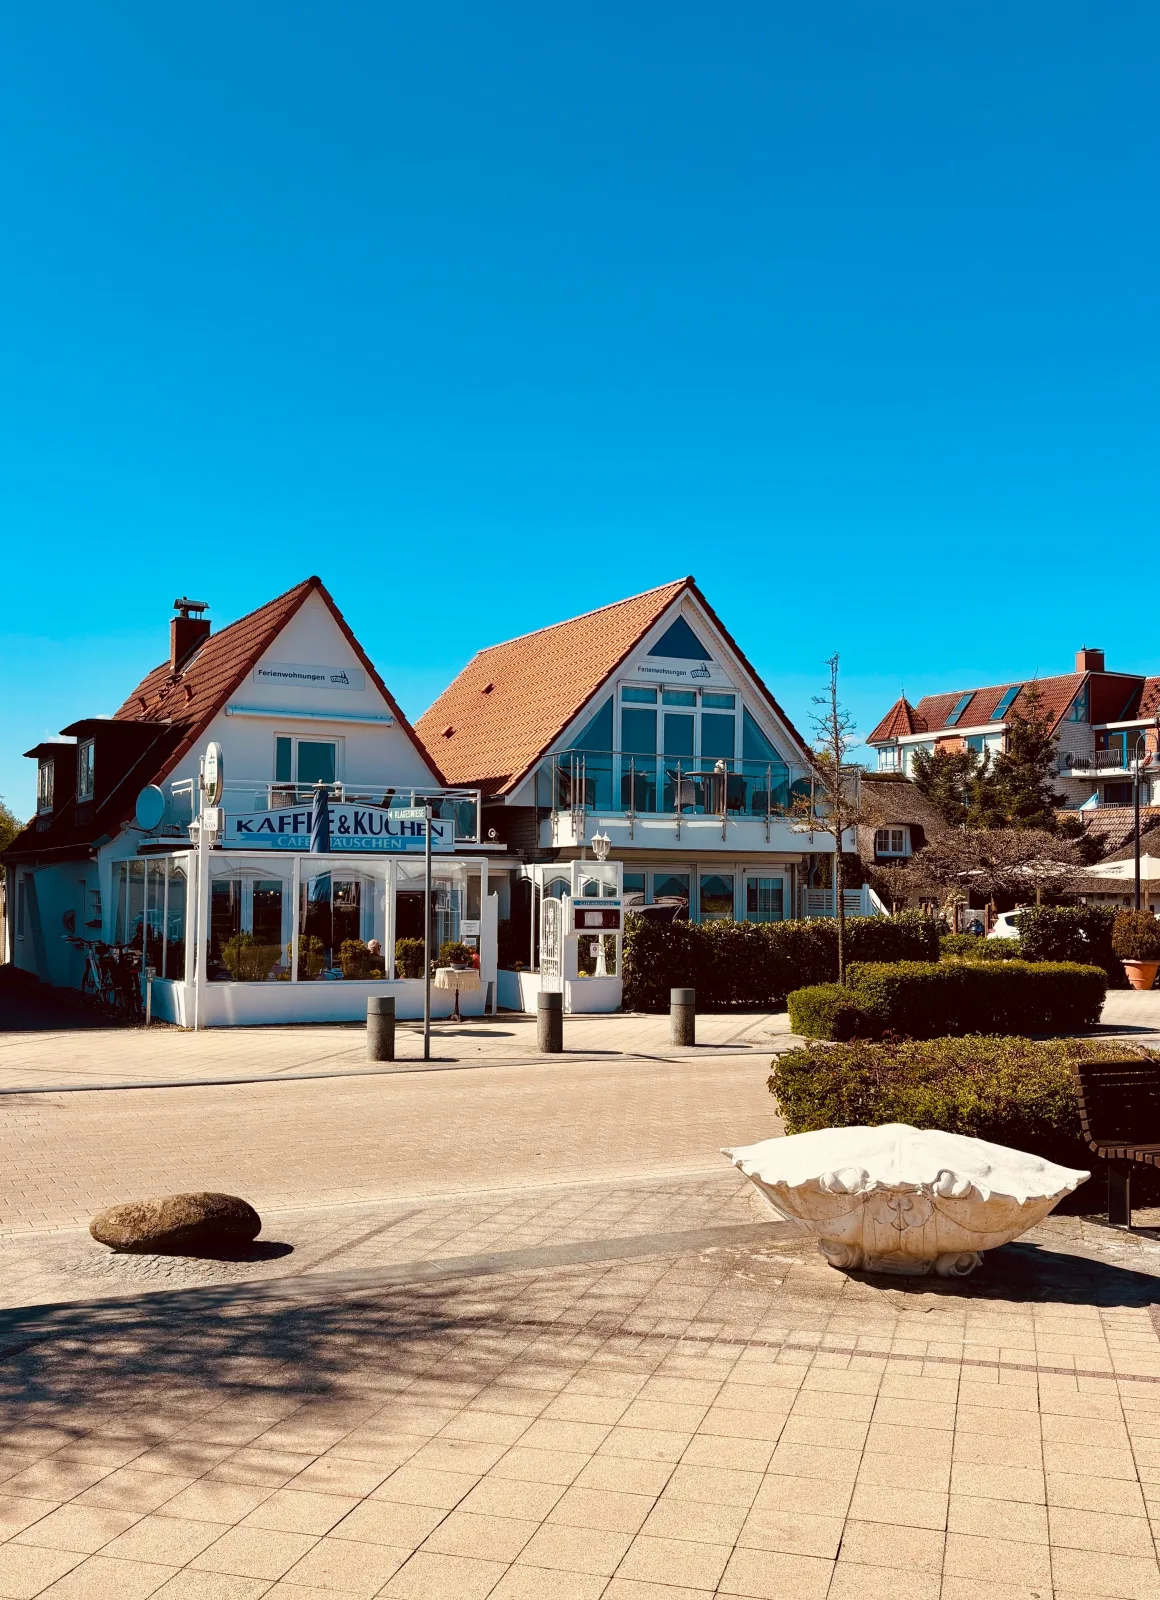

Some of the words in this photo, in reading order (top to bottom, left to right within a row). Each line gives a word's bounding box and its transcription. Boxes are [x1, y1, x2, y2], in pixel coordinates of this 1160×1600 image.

[257, 669, 325, 681] Ferienwohnungen
[637, 665, 687, 677] Ferienwohnungen
[329, 837, 402, 849] ÄUSCHEN
